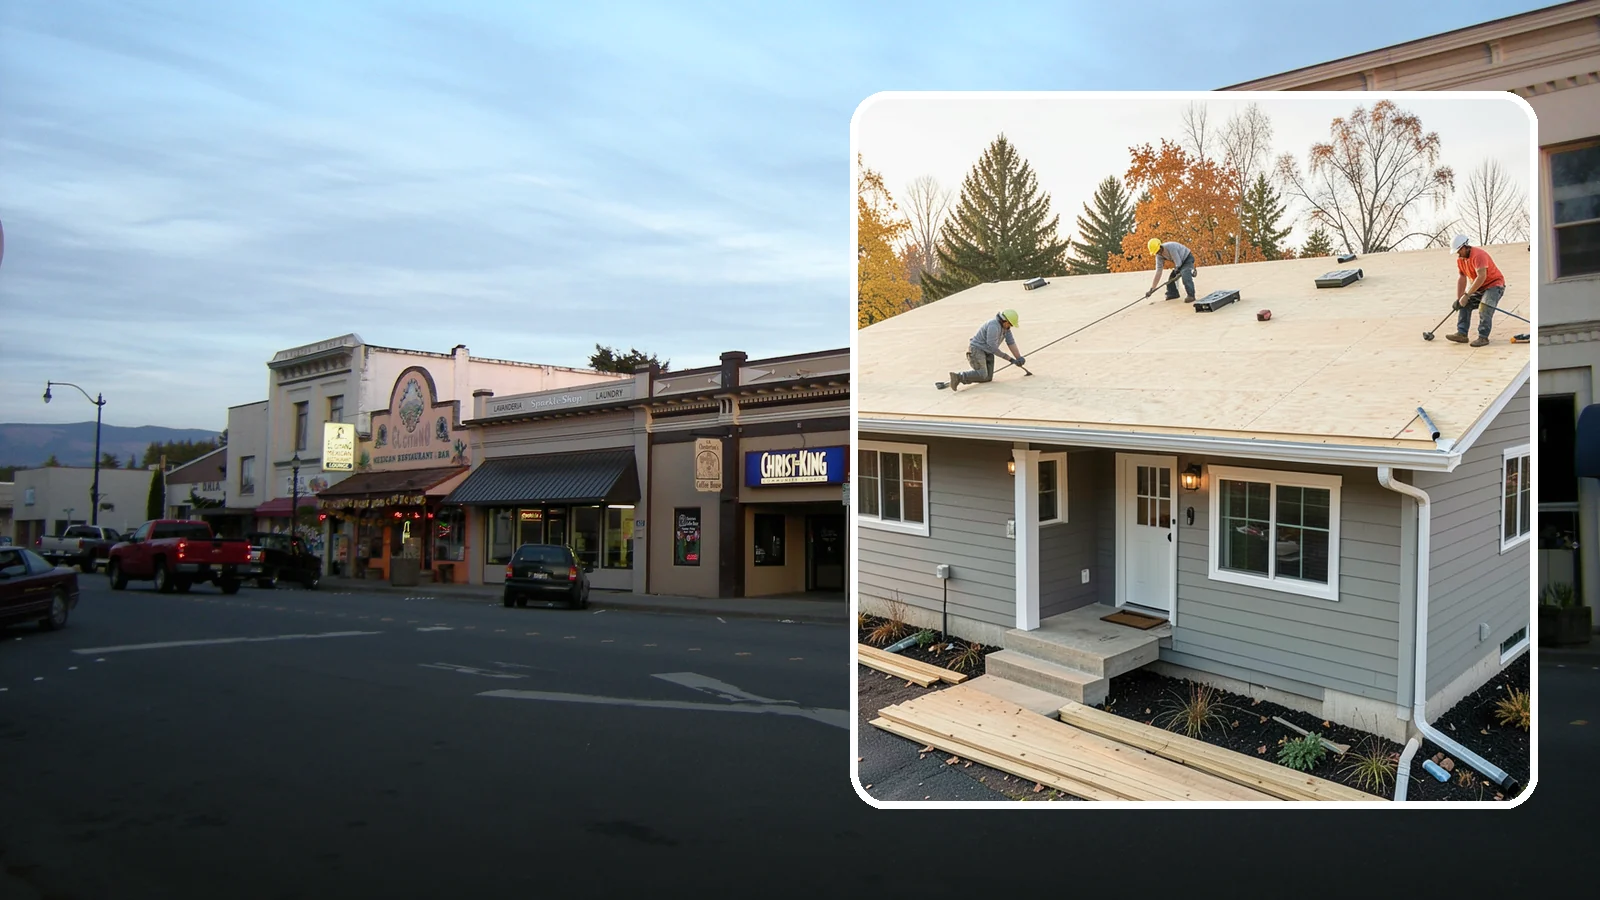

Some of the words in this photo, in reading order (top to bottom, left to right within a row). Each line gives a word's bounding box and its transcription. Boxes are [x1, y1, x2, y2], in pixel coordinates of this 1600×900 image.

[595, 389, 623, 400] LAUNDRY
[493, 402, 523, 412] LAVANDERIA
[531, 396, 561, 409] Sparkle
[562, 394, 582, 404] Shop
[374, 455, 396, 464] MEXICAN
[398, 451, 433, 462] RESTAURANT
[438, 450, 450, 459] BAR
